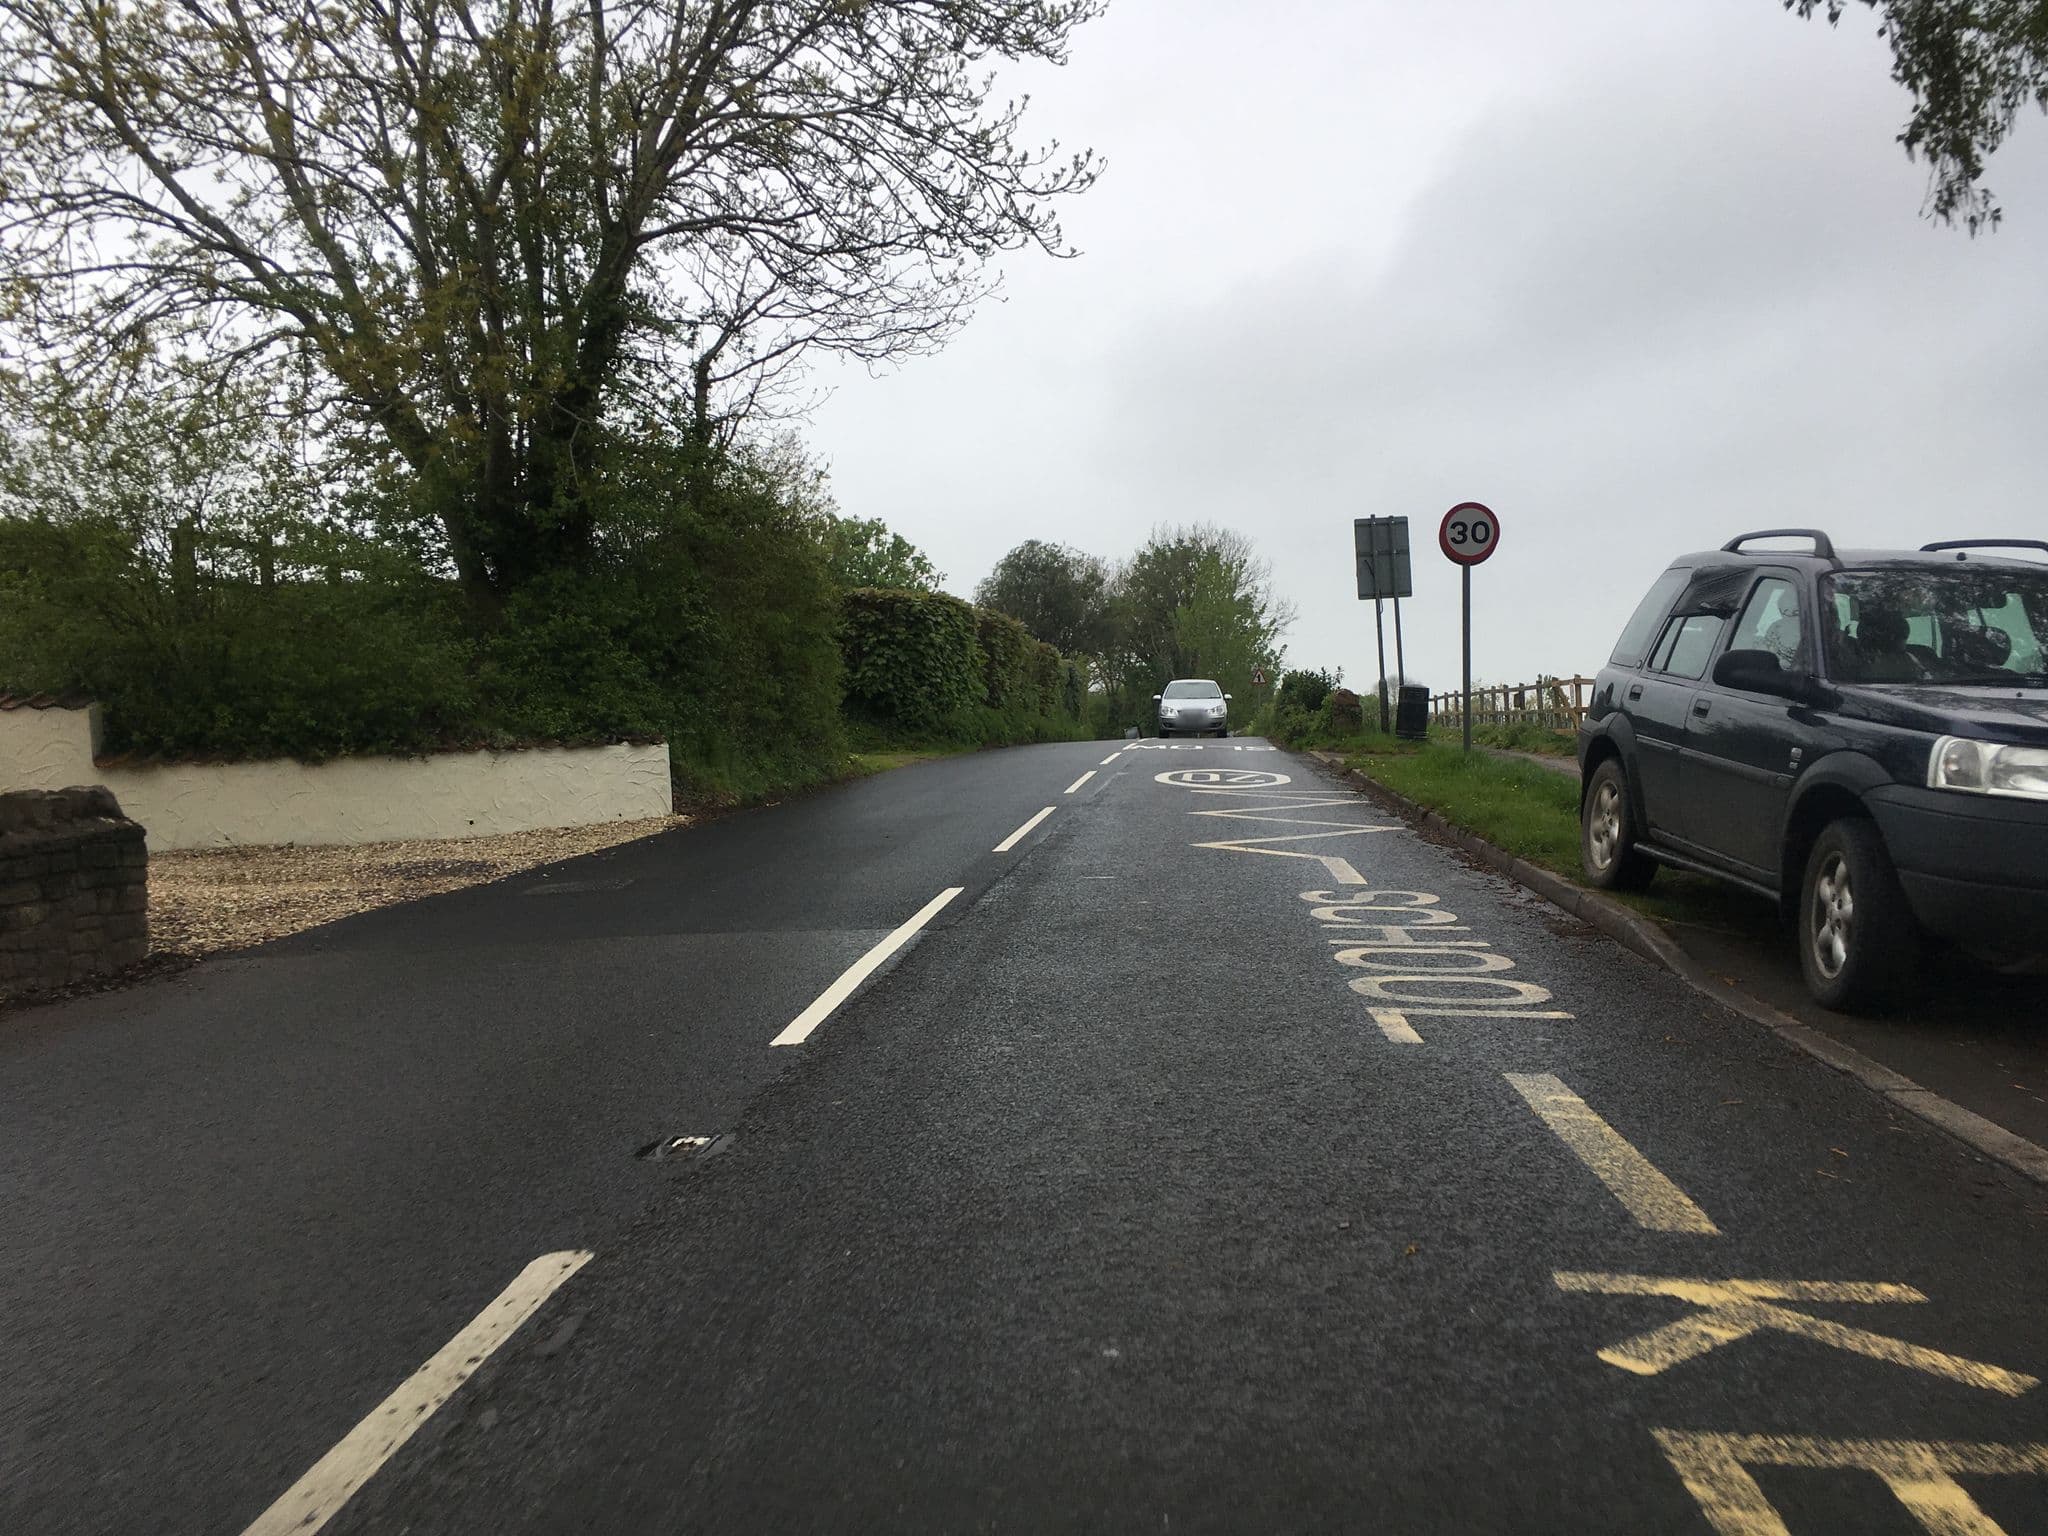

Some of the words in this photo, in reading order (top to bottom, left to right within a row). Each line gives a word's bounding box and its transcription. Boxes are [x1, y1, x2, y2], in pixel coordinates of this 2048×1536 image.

[1450, 521, 1490, 544] 30
[1182, 772, 1265, 784] 20
[1299, 890, 1575, 1044] SCHOOL
